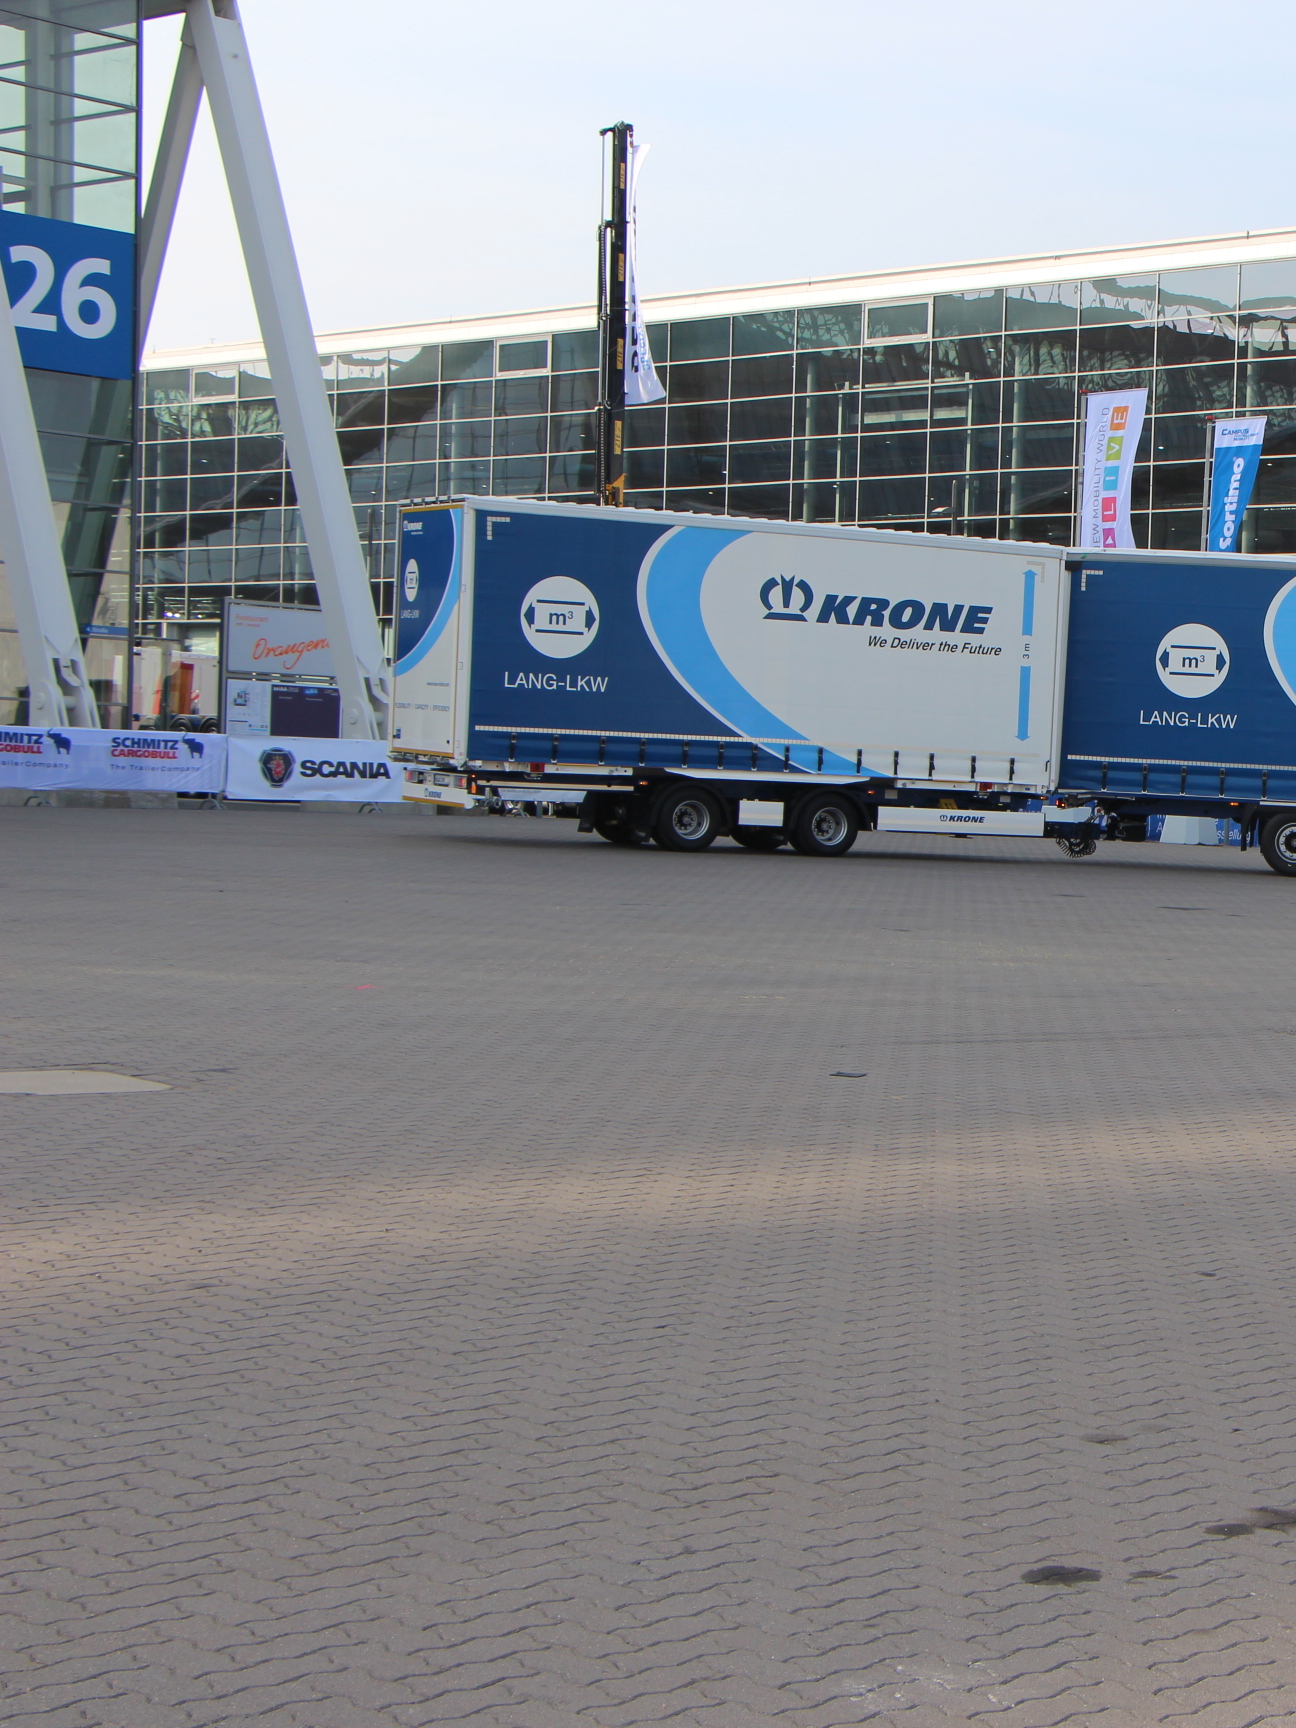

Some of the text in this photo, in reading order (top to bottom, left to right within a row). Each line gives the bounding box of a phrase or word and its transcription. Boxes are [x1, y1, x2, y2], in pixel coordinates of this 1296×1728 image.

[8, 244, 117, 340] 26
[1103, 411, 1128, 516] LIVE
[1092, 407, 1110, 548] EW MOBILITY WORLD
[816, 593, 994, 635] KRONE
[867, 635, 1002, 656] We Deliver the Future
[504, 671, 609, 693] LANG-LKW
[1140, 709, 1238, 730] LANG-LKW
[111, 737, 179, 750] SCHMITZ
[110, 749, 178, 760] CARGOBULL
[300, 759, 391, 780] SCANIA
[948, 814, 986, 825] KRONE
